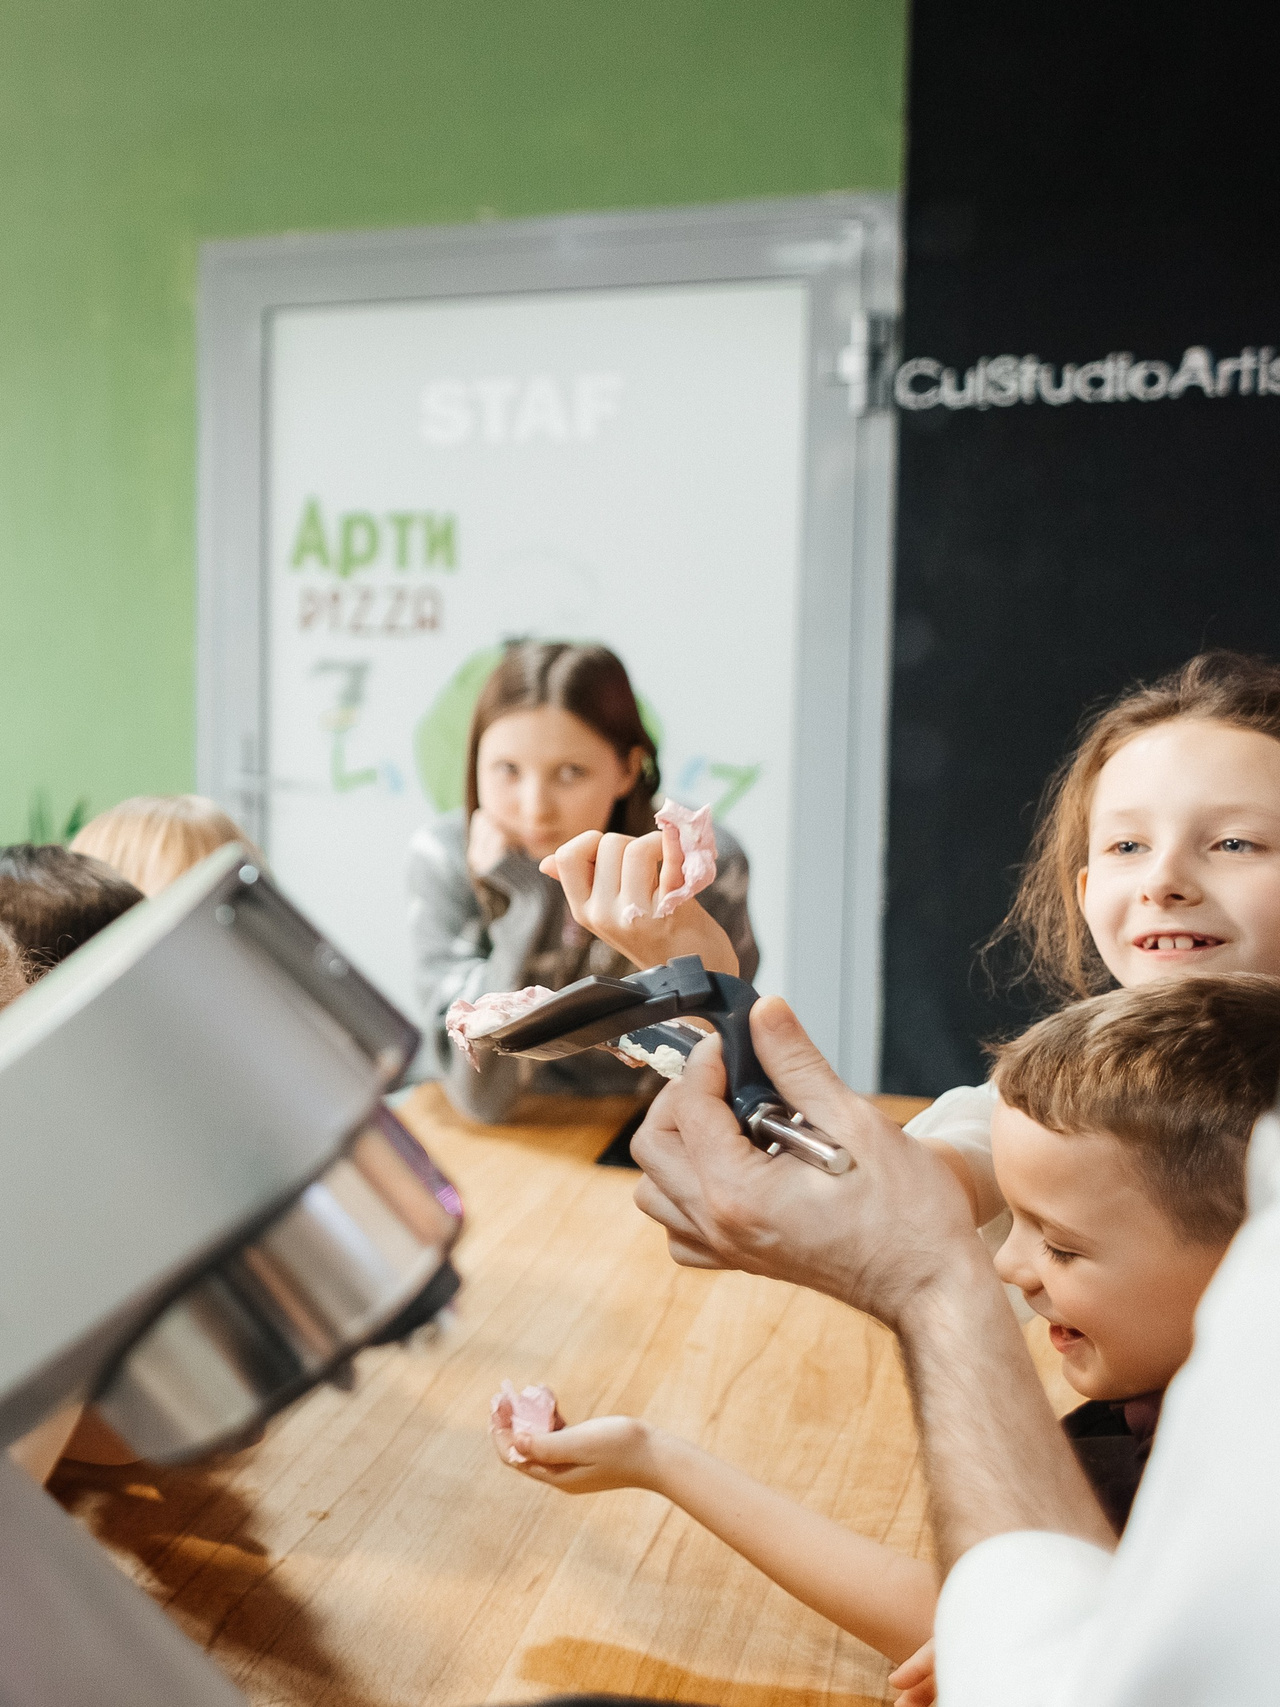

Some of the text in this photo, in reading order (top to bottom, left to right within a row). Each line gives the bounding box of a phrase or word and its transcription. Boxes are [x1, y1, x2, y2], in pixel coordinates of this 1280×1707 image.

[420, 371, 625, 447] STAF
[288, 492, 462, 580] Арти
[297, 584, 446, 635] PIZZA
